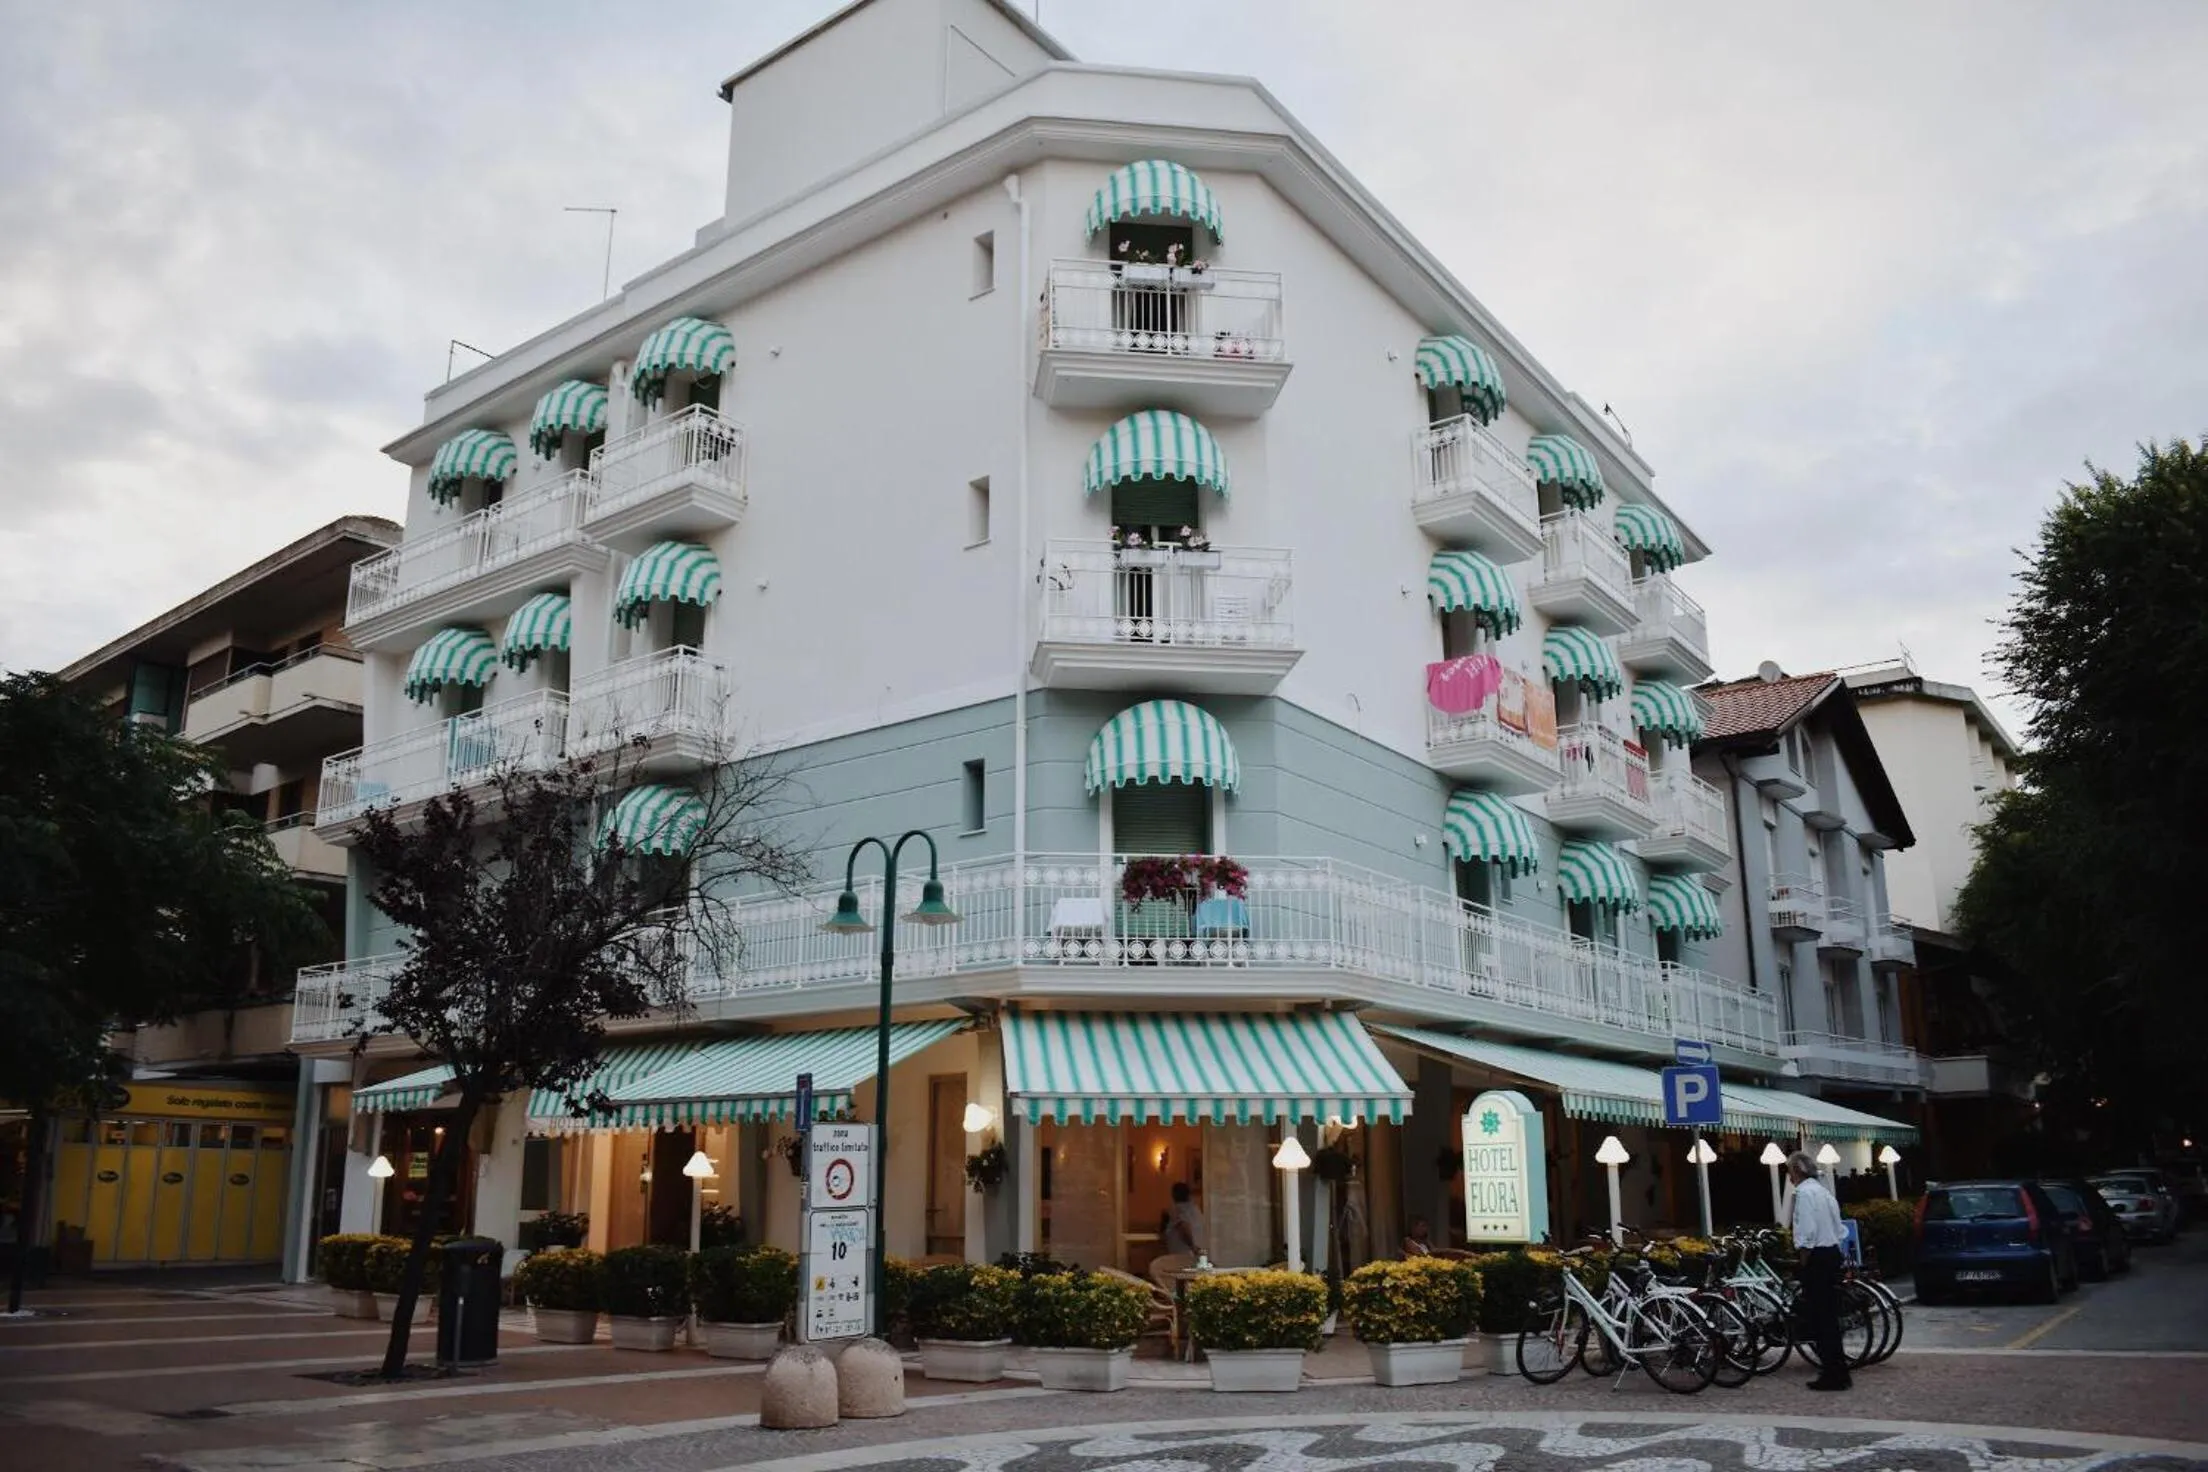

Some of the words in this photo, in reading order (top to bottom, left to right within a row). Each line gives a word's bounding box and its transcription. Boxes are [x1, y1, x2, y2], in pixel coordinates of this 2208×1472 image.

[1675, 1073, 1709, 1118] P
[1467, 1148, 1518, 1173] HOTEL
[1470, 1181, 1519, 1214] FLORA
[832, 1241, 848, 1261] 10
